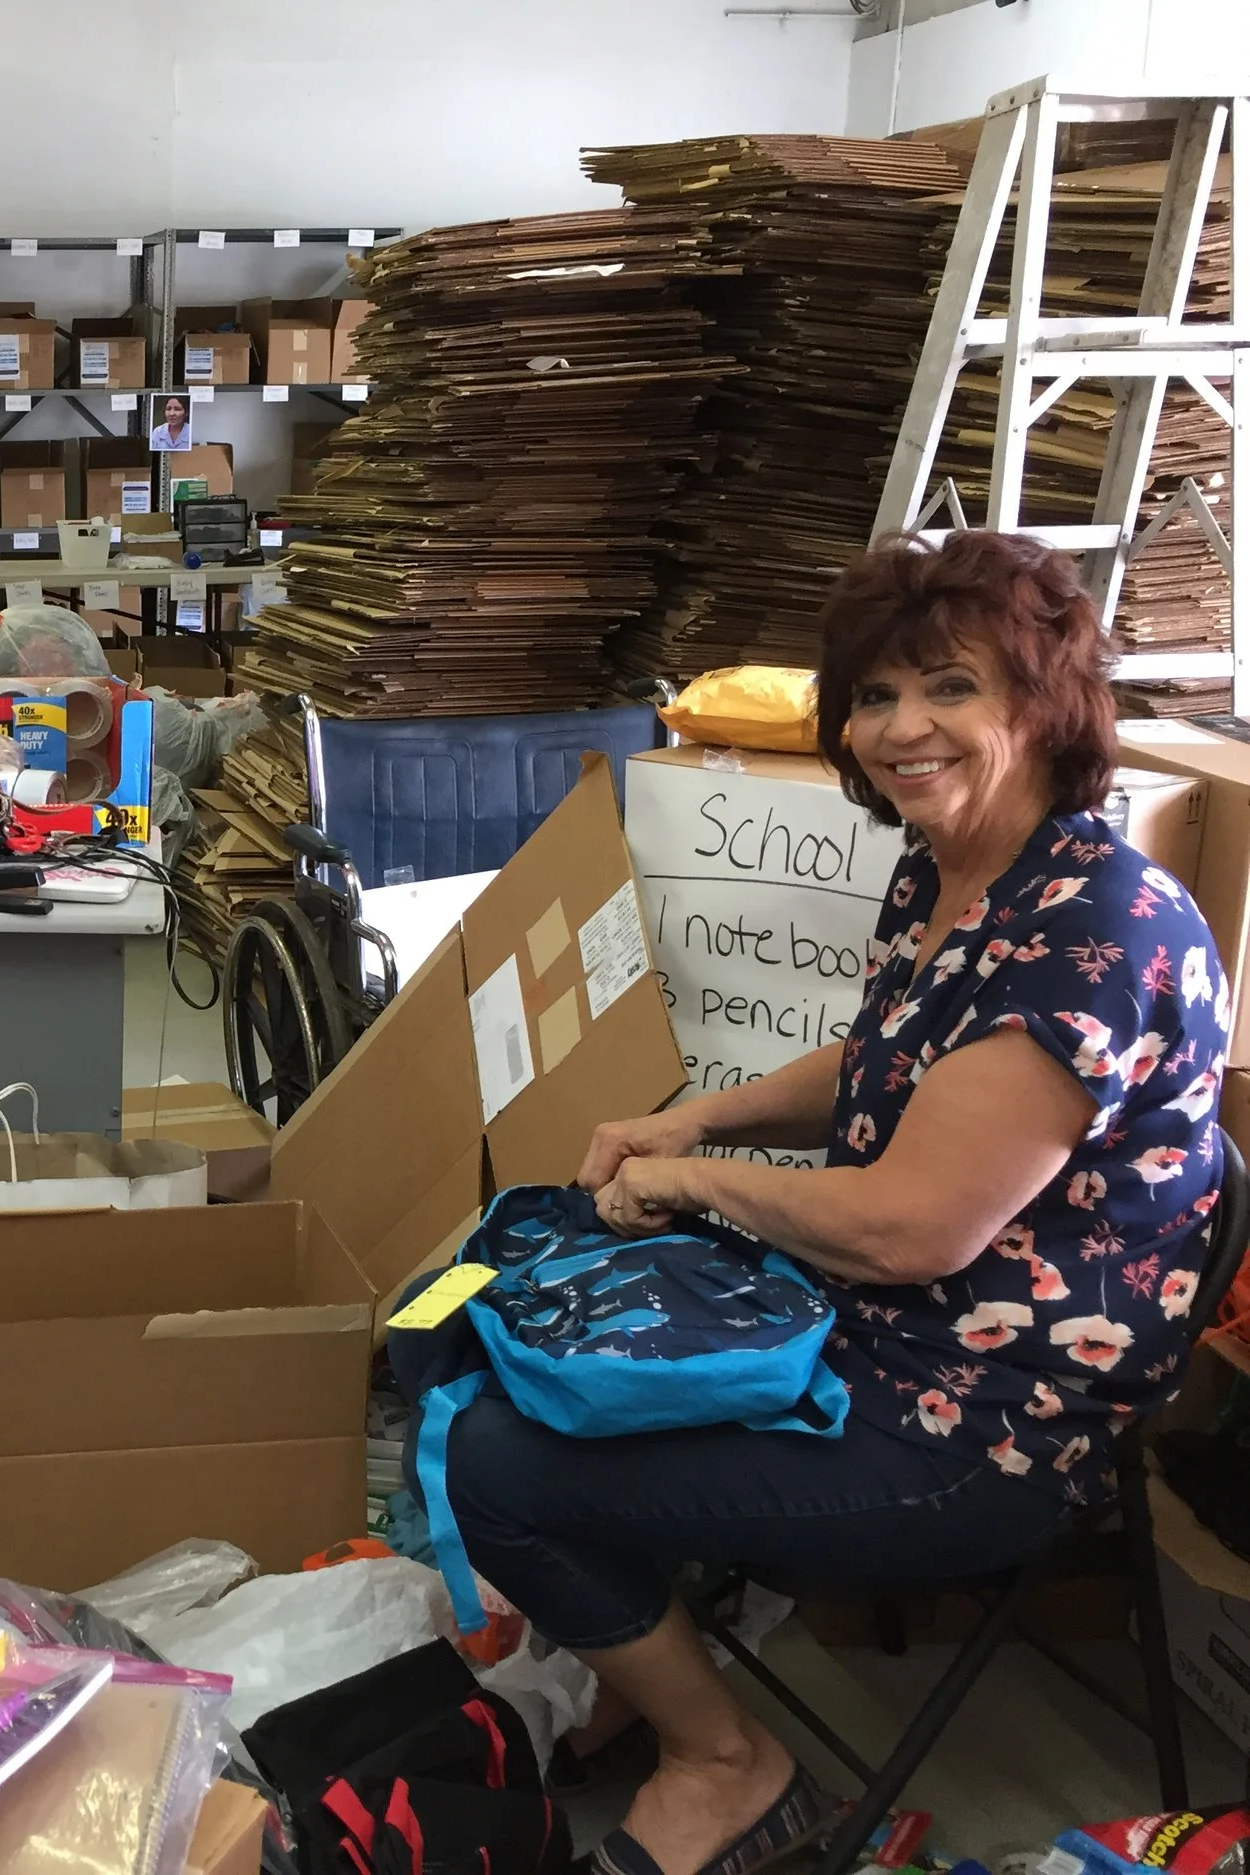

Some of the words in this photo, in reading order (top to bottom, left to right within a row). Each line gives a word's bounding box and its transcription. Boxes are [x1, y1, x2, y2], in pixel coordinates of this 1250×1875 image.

[19, 706, 36, 715] 40x
[20, 731, 49, 740] HEAVY
[20, 740, 44, 750] DUTY
[106, 808, 138, 826] 40x
[694, 792, 858, 882] School
[685, 914, 871, 979] noteboo
[653, 970, 678, 1008] 3
[701, 986, 851, 1048] pencils
[1142, 1812, 1204, 1867] Scotch
